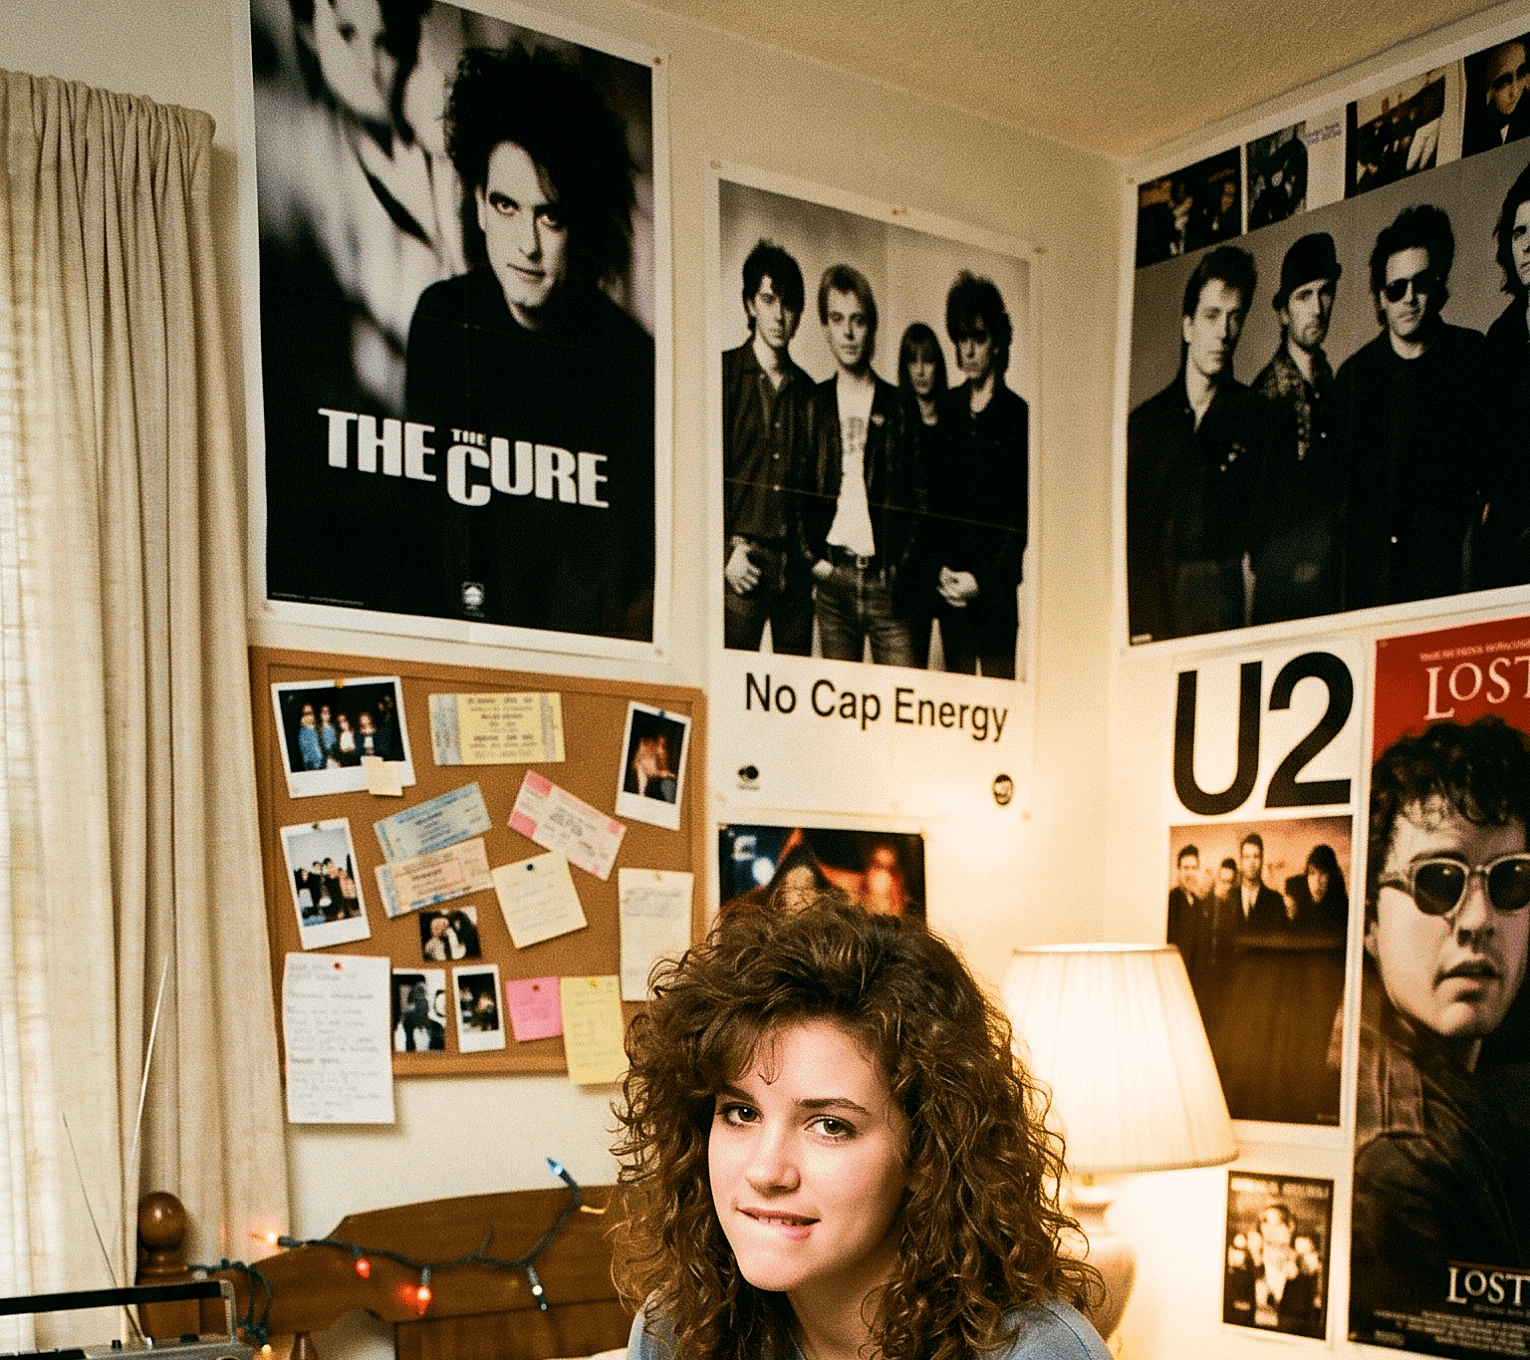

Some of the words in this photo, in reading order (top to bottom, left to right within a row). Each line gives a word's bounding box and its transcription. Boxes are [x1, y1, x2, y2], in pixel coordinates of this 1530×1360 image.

[317, 407, 437, 482] THE
[446, 436, 610, 509] CURE
[450, 428, 487, 447] THE
[745, 672, 797, 714] No
[811, 679, 882, 731] Cap
[894, 687, 1009, 743] Energy
[1173, 651, 1355, 817] U2
[1445, 1266, 1530, 1307] LOST
